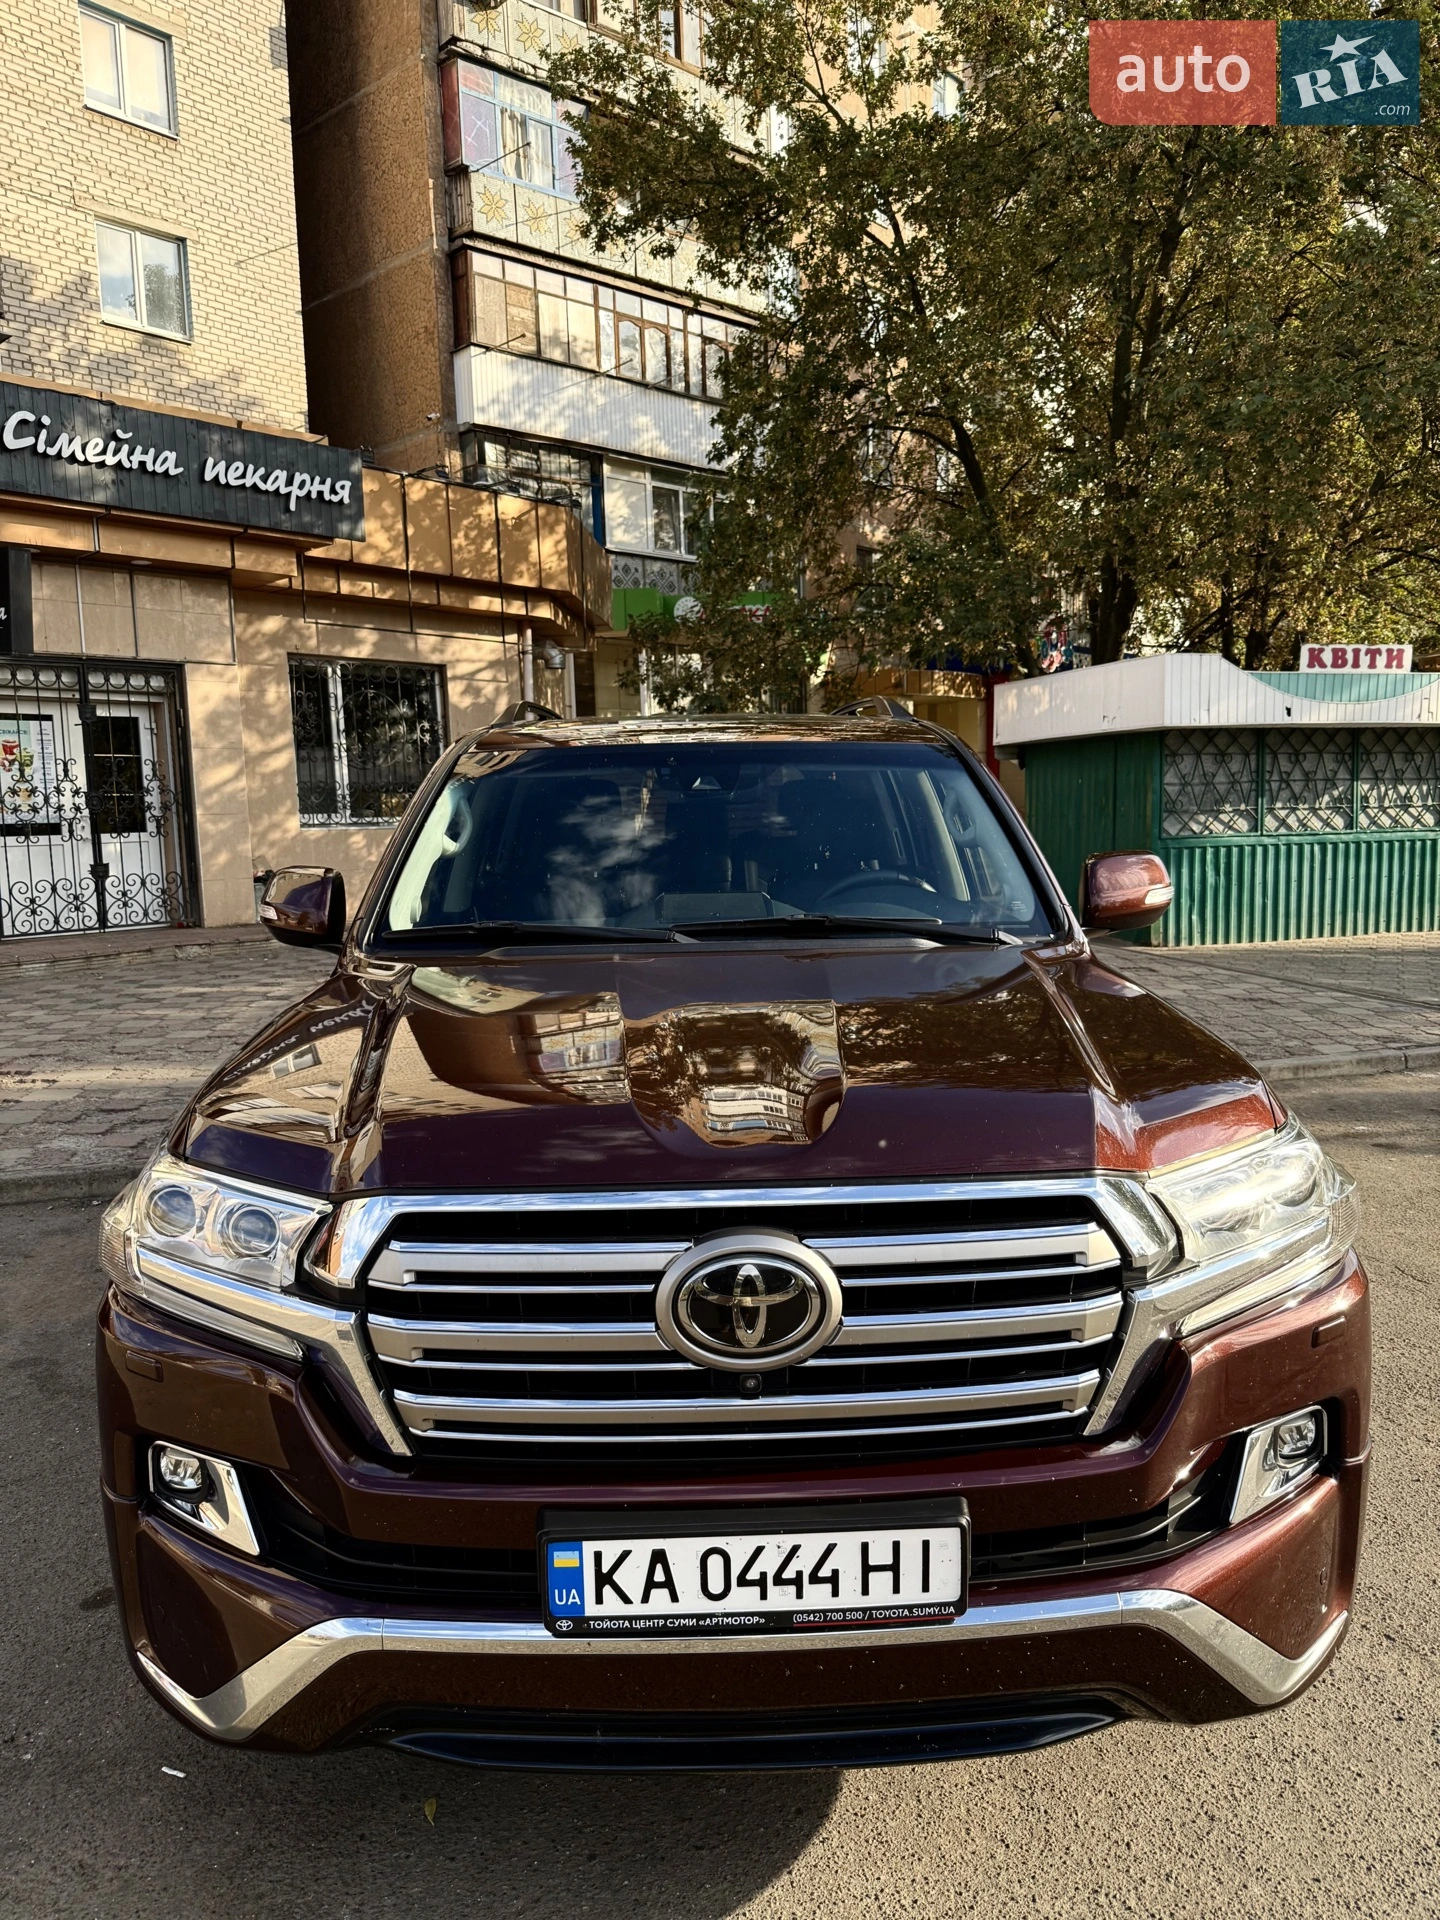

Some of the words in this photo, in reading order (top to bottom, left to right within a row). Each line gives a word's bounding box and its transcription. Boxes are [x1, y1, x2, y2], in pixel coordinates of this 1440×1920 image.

[3, 410, 184, 476] Сімейна
[203, 456, 352, 511] пекарня
[1306, 647, 1405, 669] КВІТИ
[594, 1548, 680, 1605] KA
[700, 1542, 840, 1602] 0444
[861, 1539, 931, 1596] HI
[554, 1588, 581, 1605] UA
[589, 1619, 631, 1629] ТОЙОТА
[632, 1619, 665, 1630] ЦЕНТР
[666, 1617, 697, 1627] СУМИ
[698, 1616, 766, 1627] «АРТМОТОР»
[793, 1612, 824, 1623] (0542)
[826, 1612, 845, 1621] 700
[846, 1611, 862, 1620] 500
[871, 1606, 955, 1619] TOYOTA.SUMY.UA
